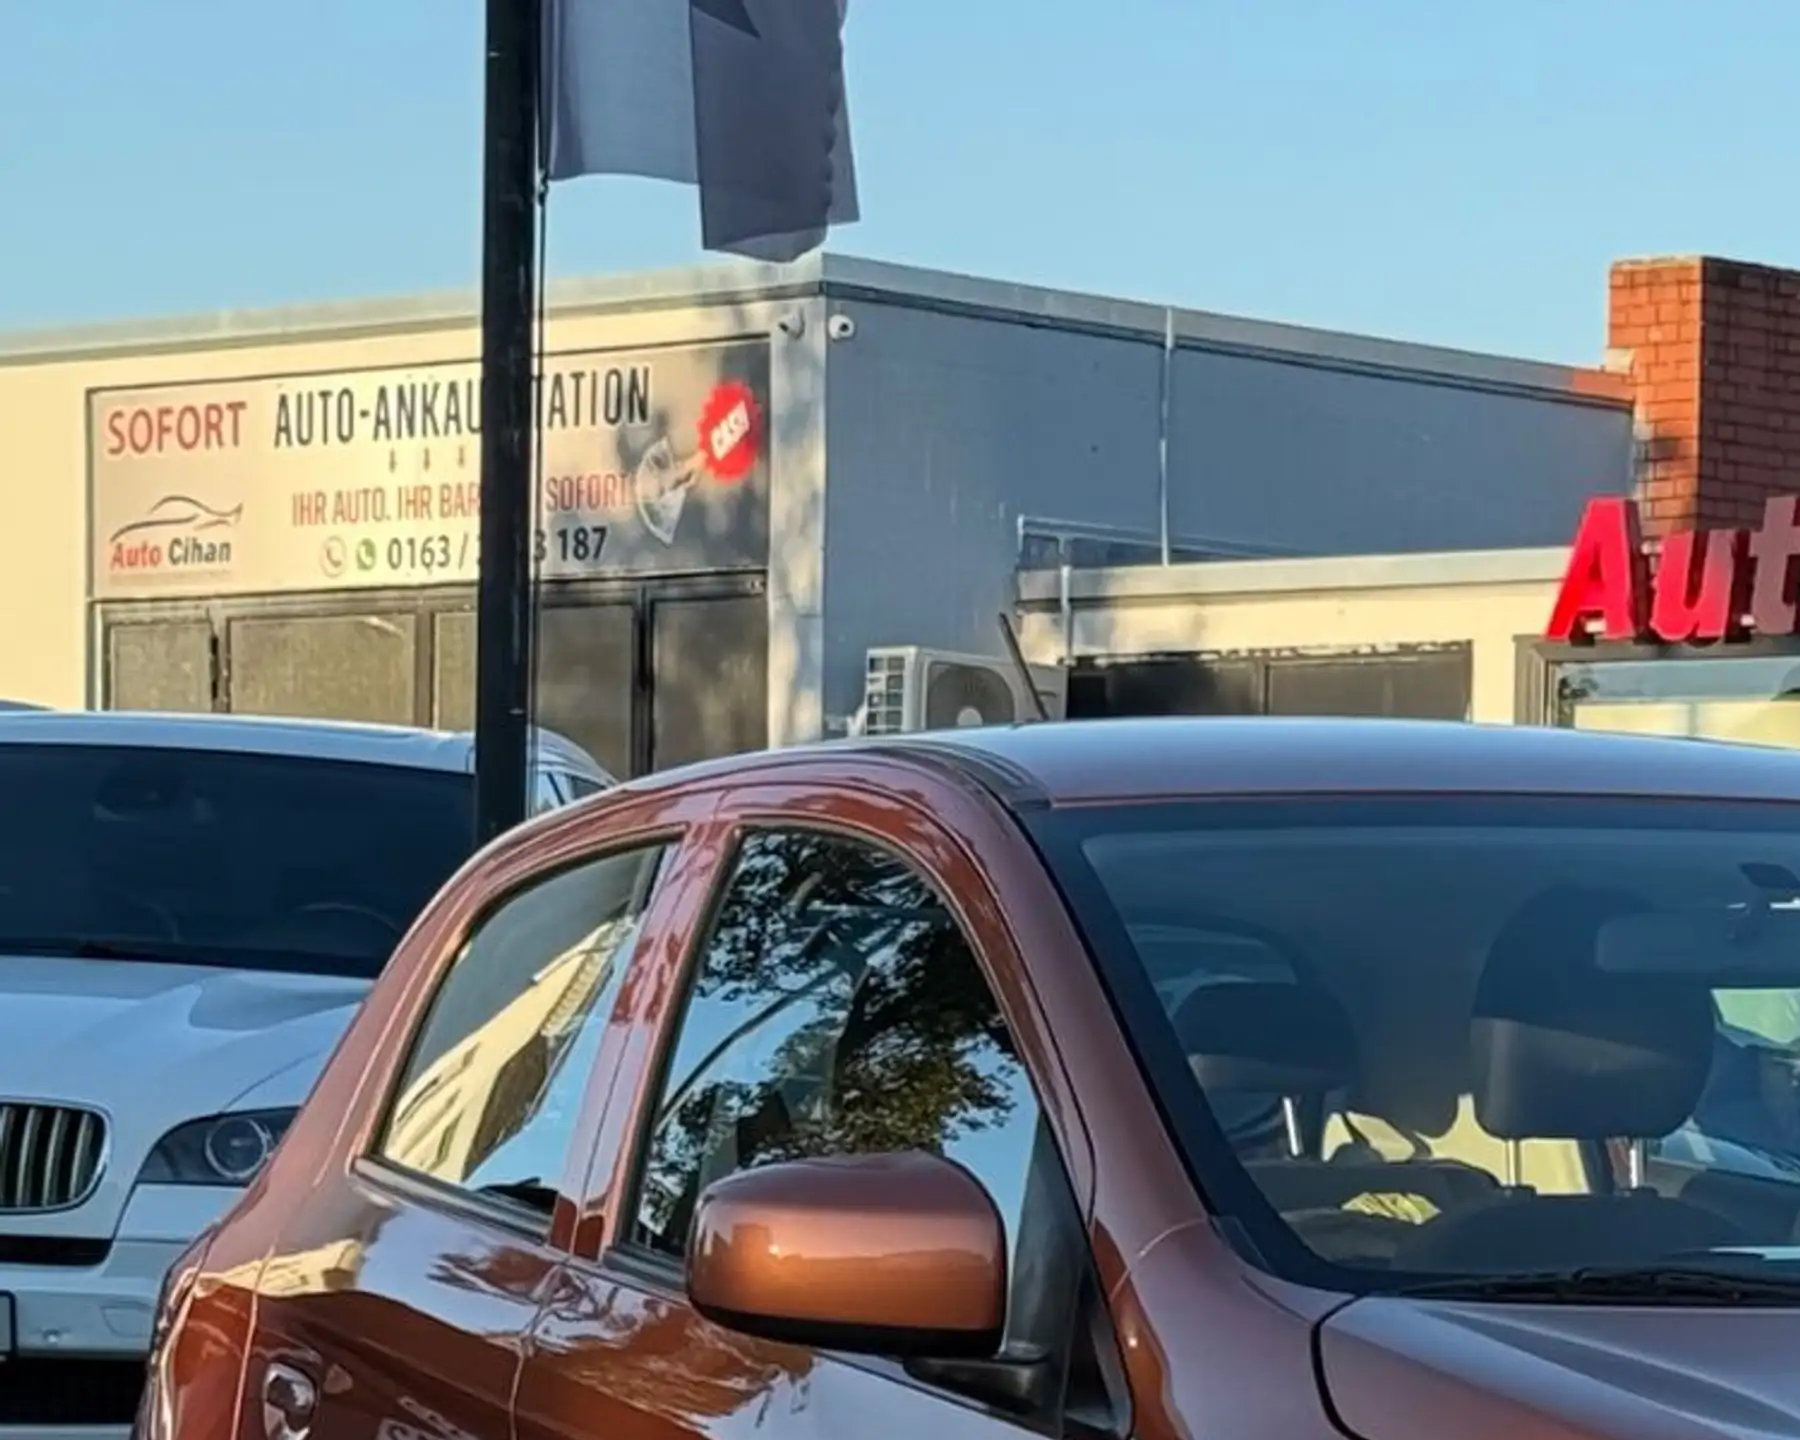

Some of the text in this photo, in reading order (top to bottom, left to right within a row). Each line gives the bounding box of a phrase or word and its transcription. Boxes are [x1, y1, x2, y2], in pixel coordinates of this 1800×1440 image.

[107, 401, 247, 455] SOFORT
[292, 491, 327, 527] IHR
[332, 487, 391, 524] AUTO.
[398, 484, 432, 521] IHR
[110, 537, 231, 570] Auto Cihan
[387, 535, 451, 570] 0163
[557, 526, 607, 561] 187
